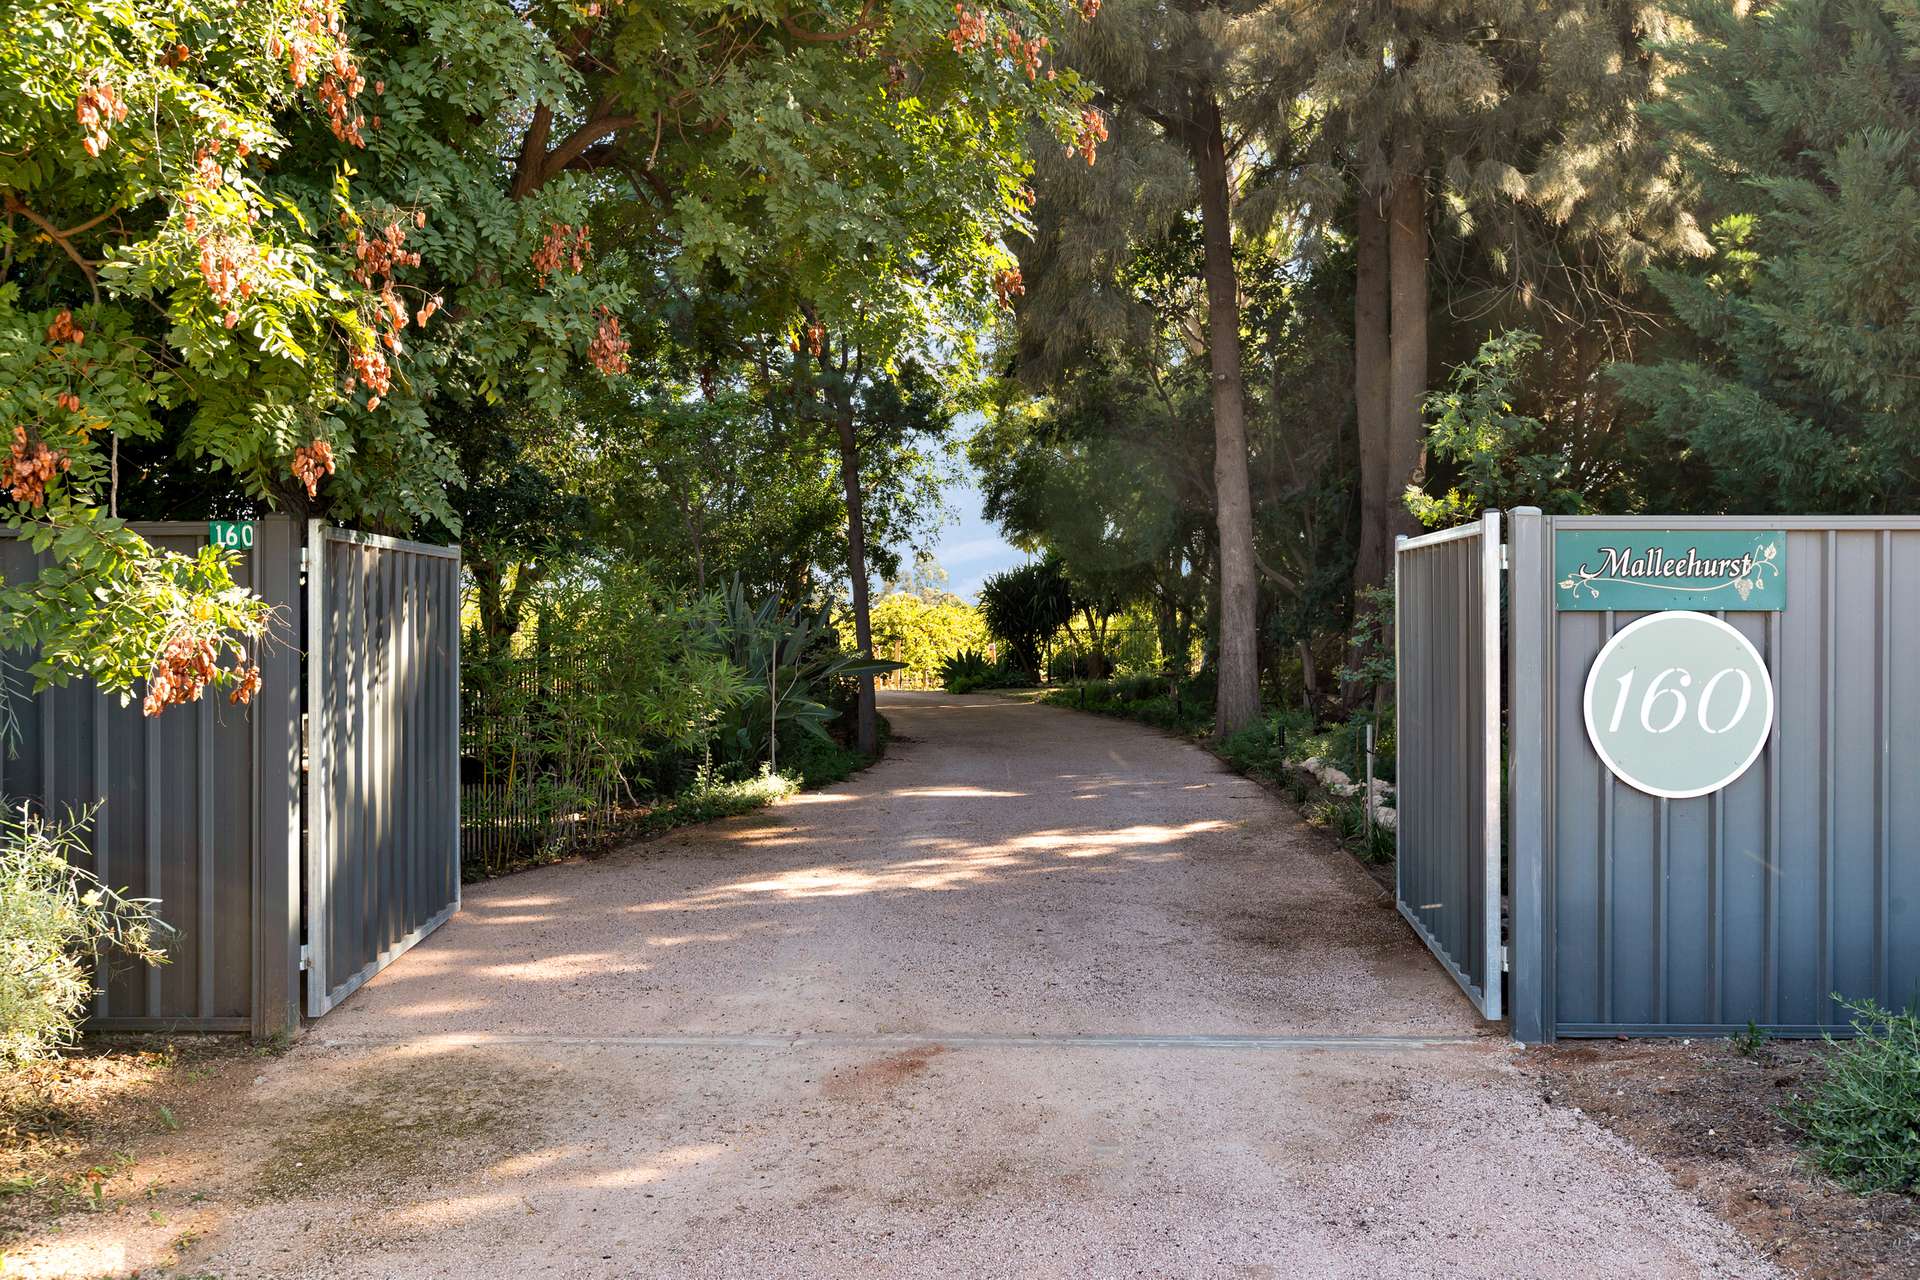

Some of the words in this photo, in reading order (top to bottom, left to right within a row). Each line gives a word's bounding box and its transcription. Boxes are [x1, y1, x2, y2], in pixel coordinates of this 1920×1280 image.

[215, 525, 254, 546] 160
[1579, 547, 1752, 580] Malleehurst
[1608, 667, 1752, 734] 160
